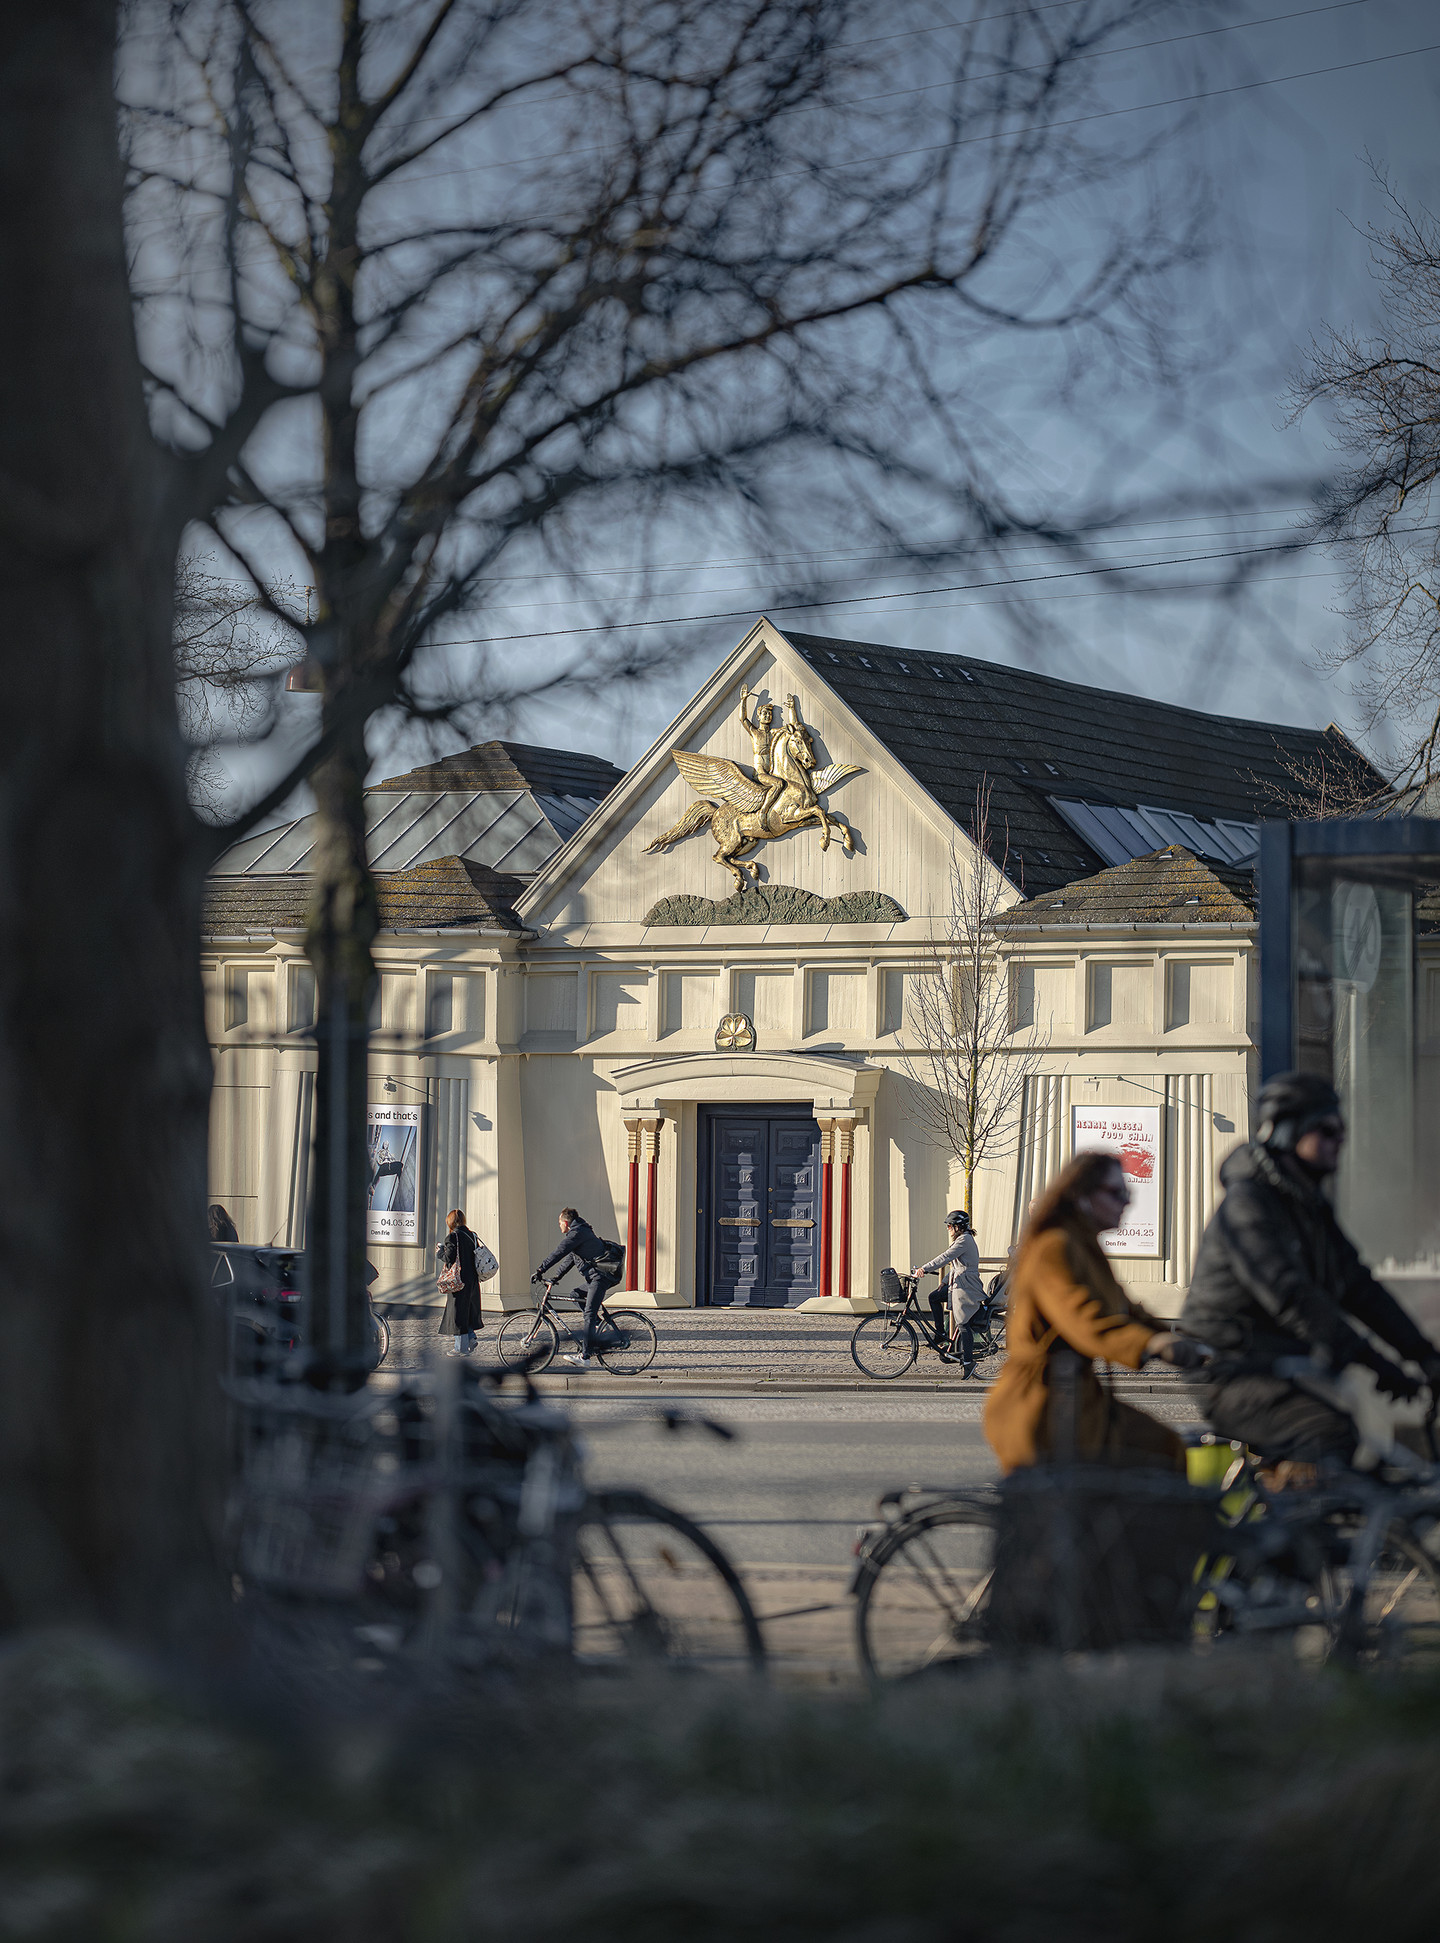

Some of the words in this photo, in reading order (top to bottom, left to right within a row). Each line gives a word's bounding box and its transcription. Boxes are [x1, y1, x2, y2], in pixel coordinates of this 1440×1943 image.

[375, 1111, 391, 1119] and
[393, 1111, 418, 1120] that's
[1077, 1120, 1107, 1130] HENRIK
[1112, 1121, 1143, 1131] OLESEN
[1101, 1131, 1123, 1140] FOOD
[1128, 1133, 1153, 1142] CHAIN
[381, 1219, 415, 1227] 04.05.25
[1117, 1228, 1154, 1237] 20.04.25
